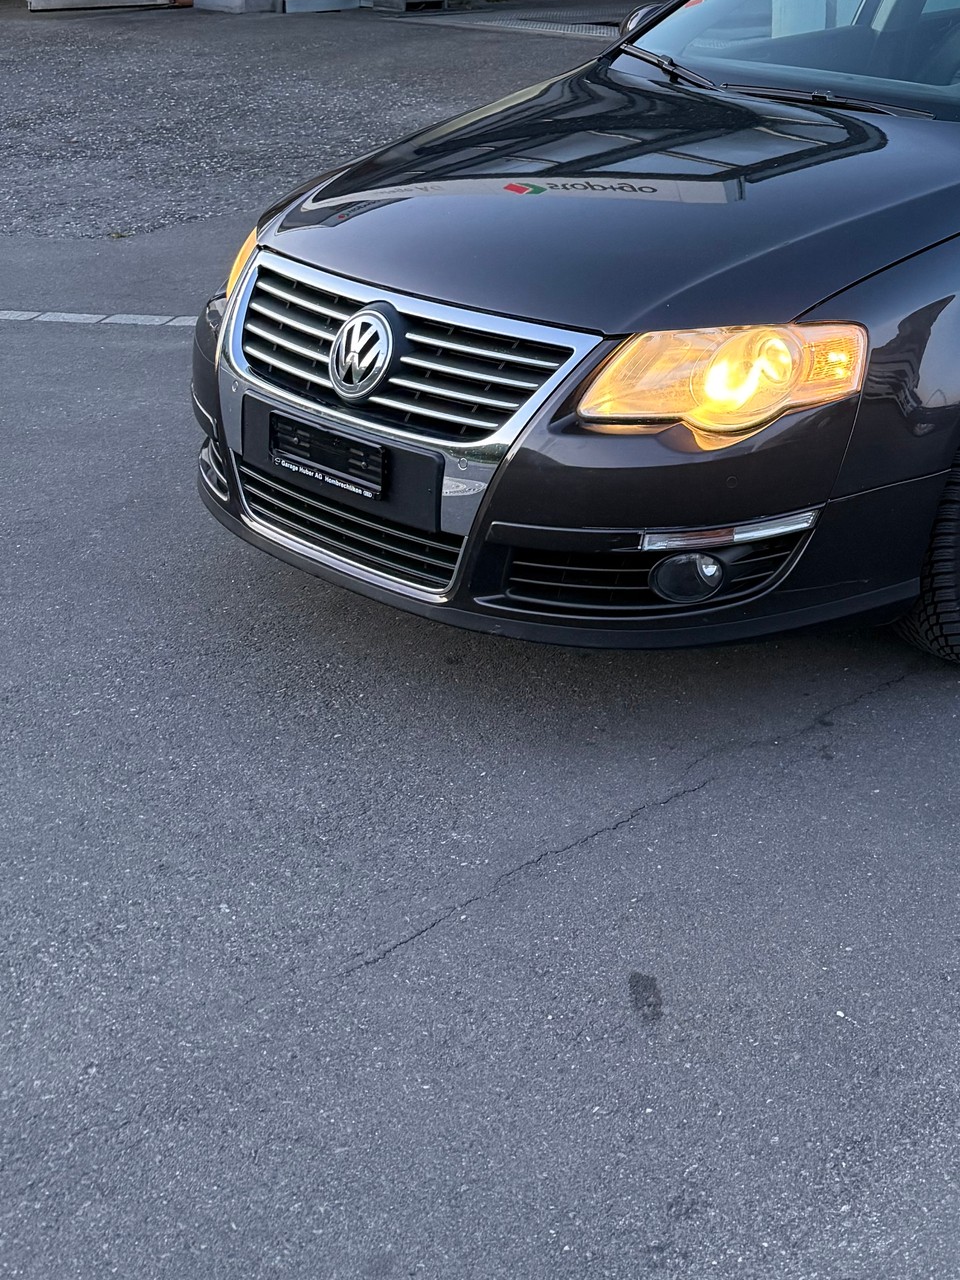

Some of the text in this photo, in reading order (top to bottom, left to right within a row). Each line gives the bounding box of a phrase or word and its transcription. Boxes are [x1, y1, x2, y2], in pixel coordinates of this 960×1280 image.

[329, 310, 393, 398] VW
[281, 460, 299, 472] Garage
[299, 466, 314, 477] Huber
[314, 471, 323, 481] AG
